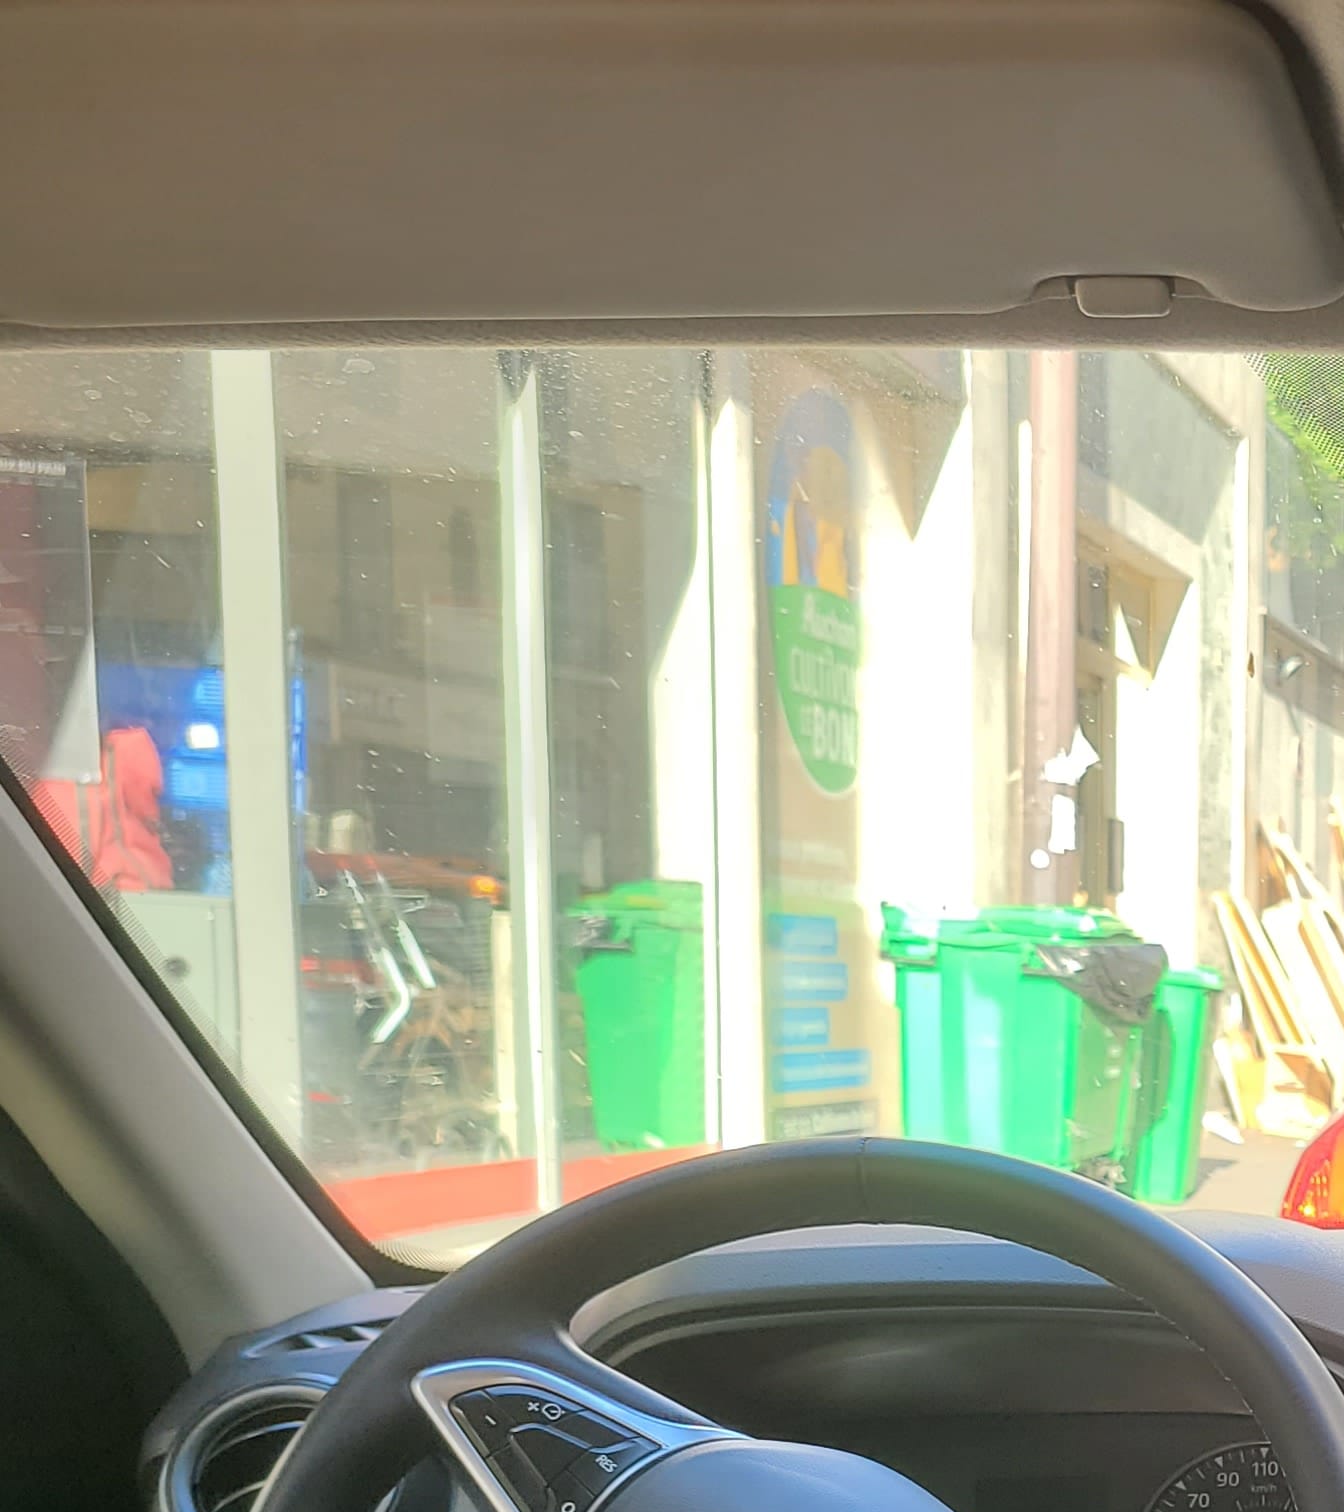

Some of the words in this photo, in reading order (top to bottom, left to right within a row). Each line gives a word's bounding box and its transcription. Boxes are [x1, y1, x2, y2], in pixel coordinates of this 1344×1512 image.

[595, 1455, 618, 1473] RES
[1252, 1461, 1279, 1476] 110
[1216, 1471, 1240, 1487] 90
[1251, 1484, 1277, 1493] km/h
[1187, 1493, 1210, 1508] 70
